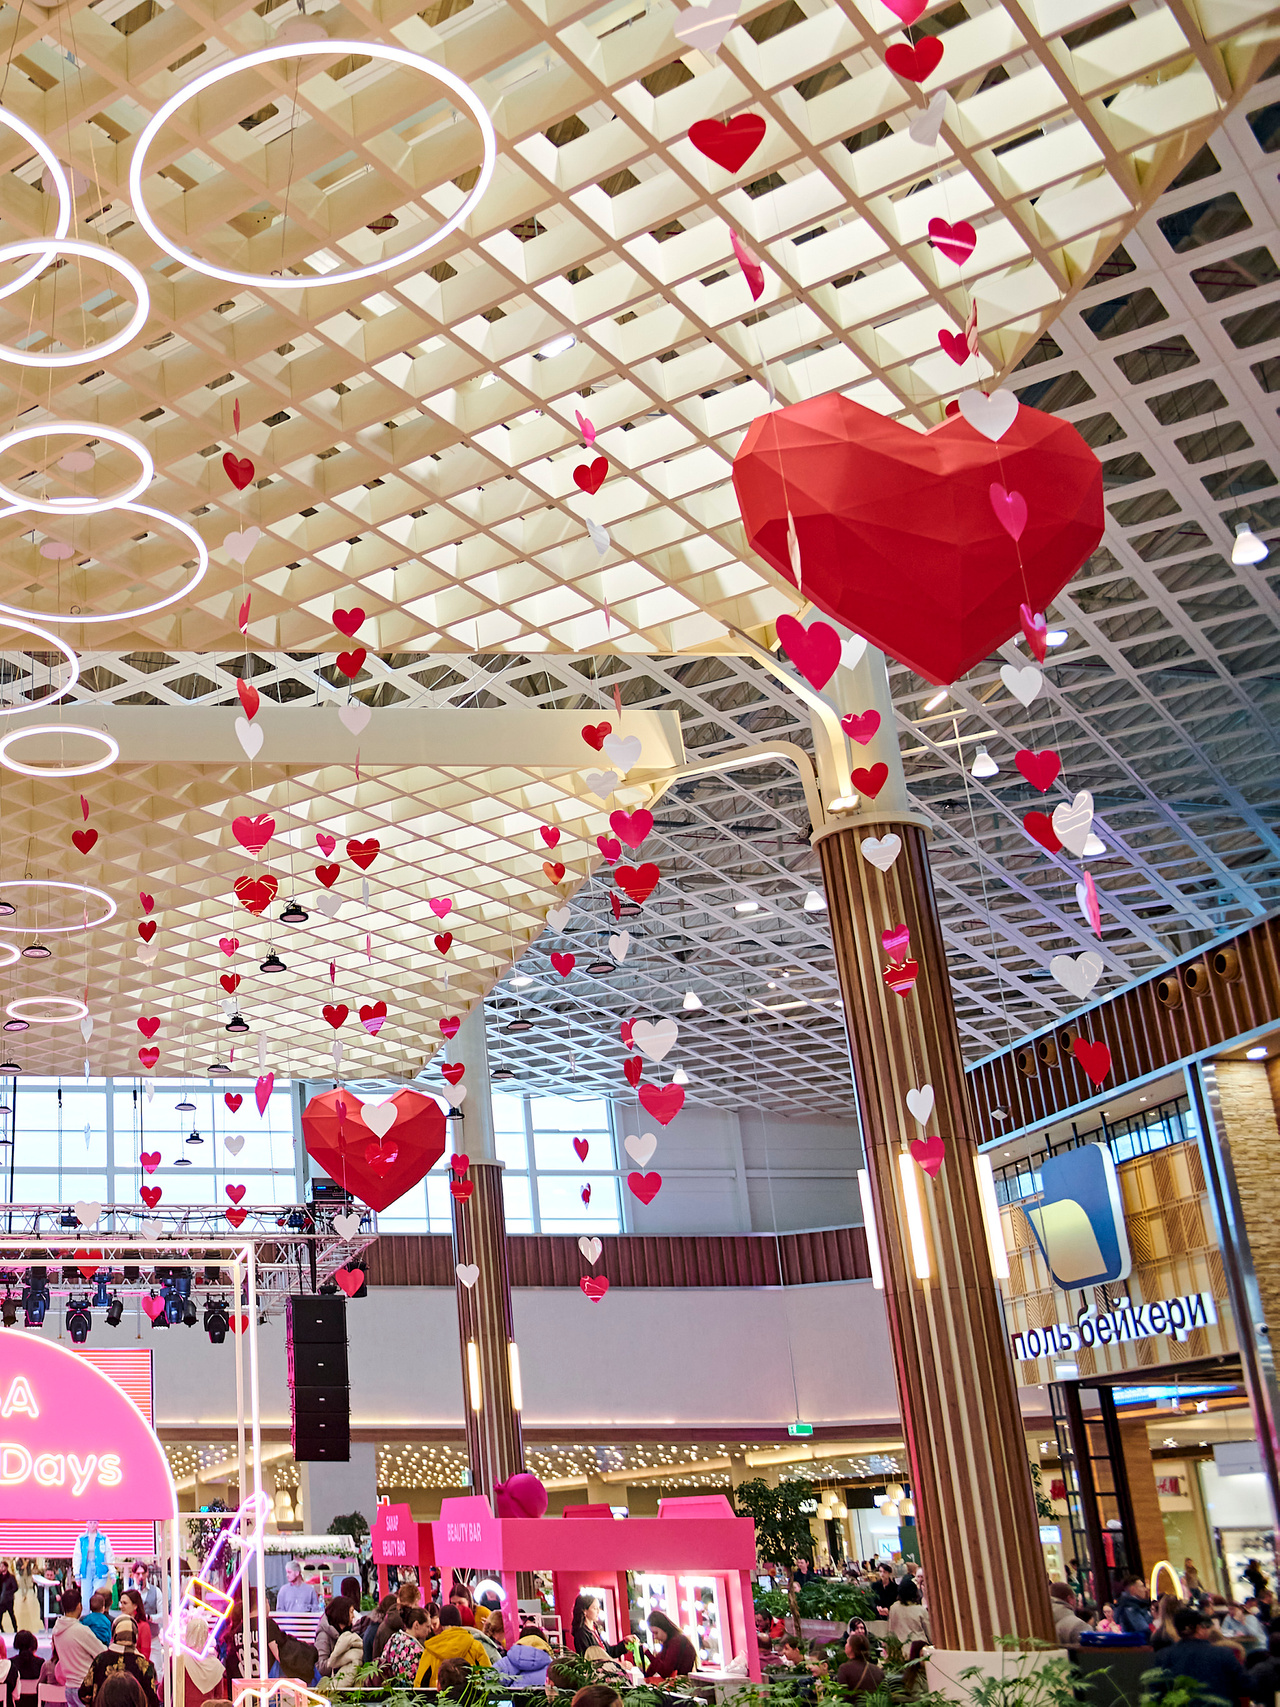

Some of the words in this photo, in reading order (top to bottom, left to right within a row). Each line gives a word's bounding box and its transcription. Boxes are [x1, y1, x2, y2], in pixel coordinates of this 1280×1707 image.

[1011, 1324, 1075, 1360] поль
[1077, 1292, 1212, 1347] бейкери
[447, 1523, 470, 1542] BEAUTY
[469, 1523, 482, 1542] BAR
